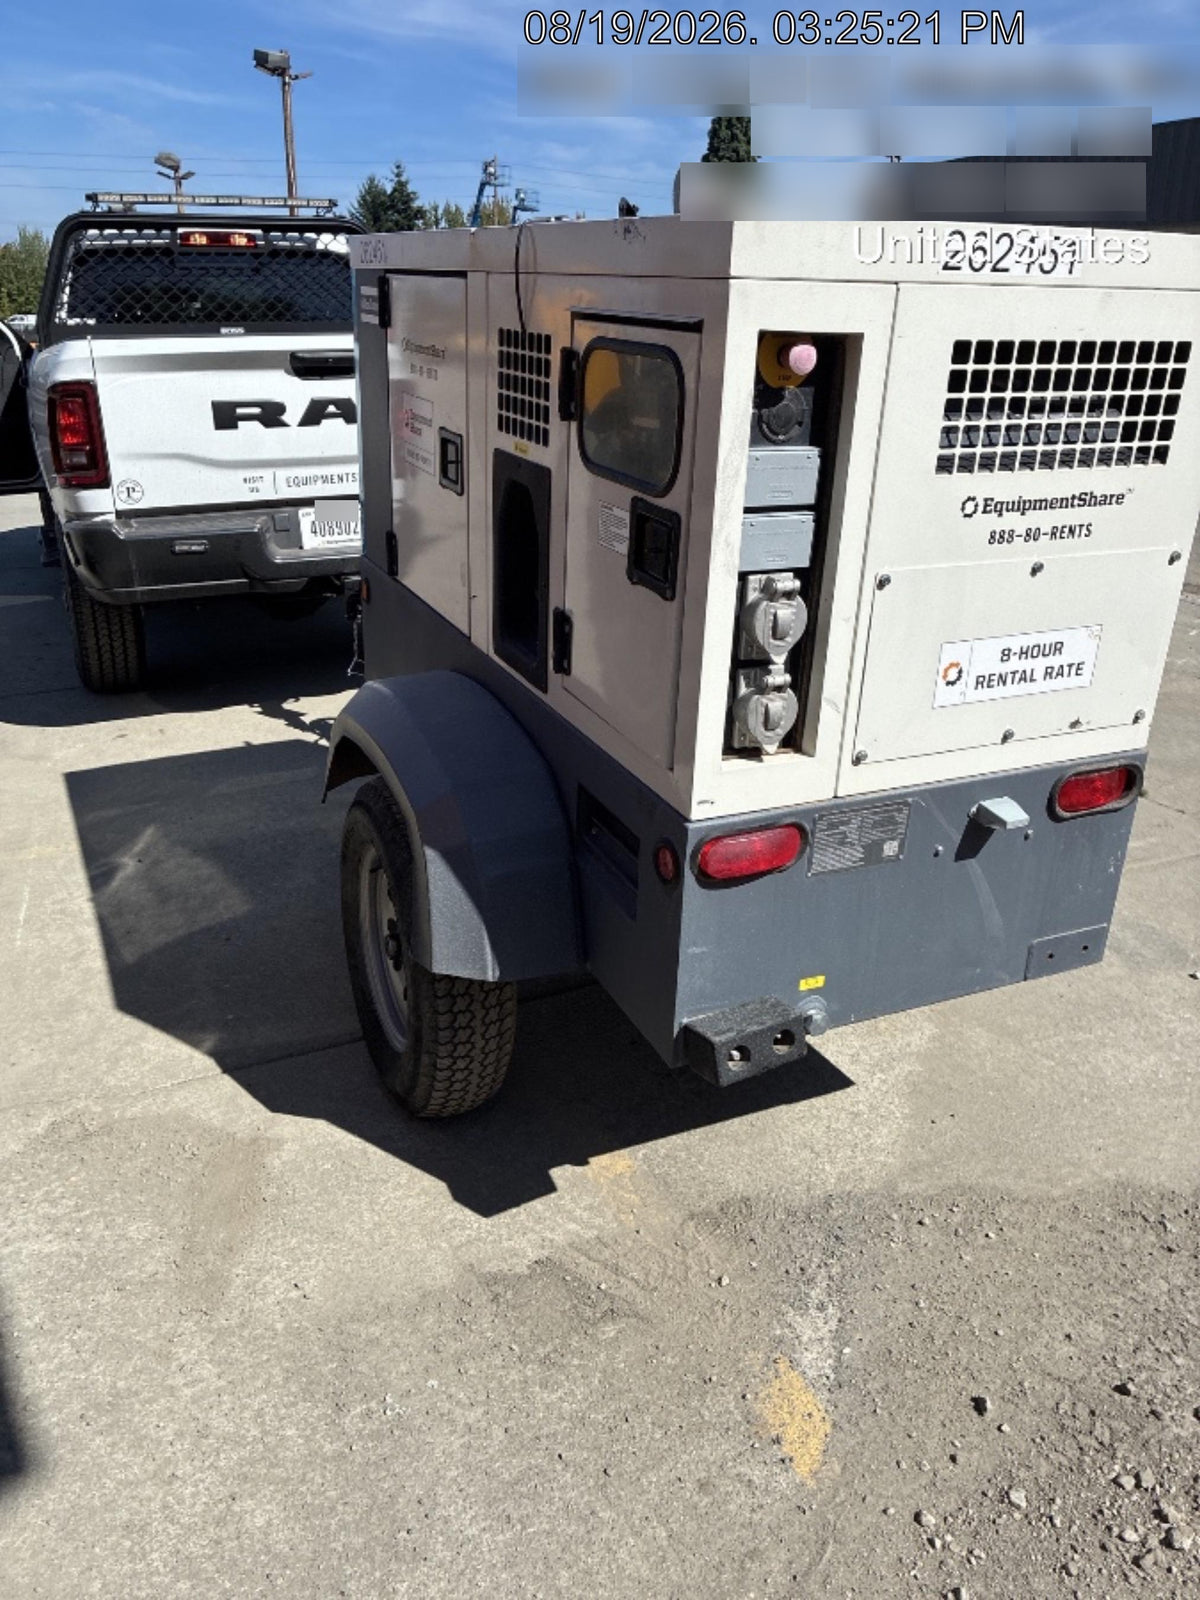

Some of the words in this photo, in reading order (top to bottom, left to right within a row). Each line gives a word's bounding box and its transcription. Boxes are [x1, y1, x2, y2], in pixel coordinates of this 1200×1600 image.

[981, 491, 1125, 518] EquipmentShare
[988, 522, 1093, 545] 888-80-RENTS
[1000, 641, 1064, 663] 8-HOUR
[974, 668, 1037, 690] RENTAL
[1043, 661, 1086, 681] RATE
